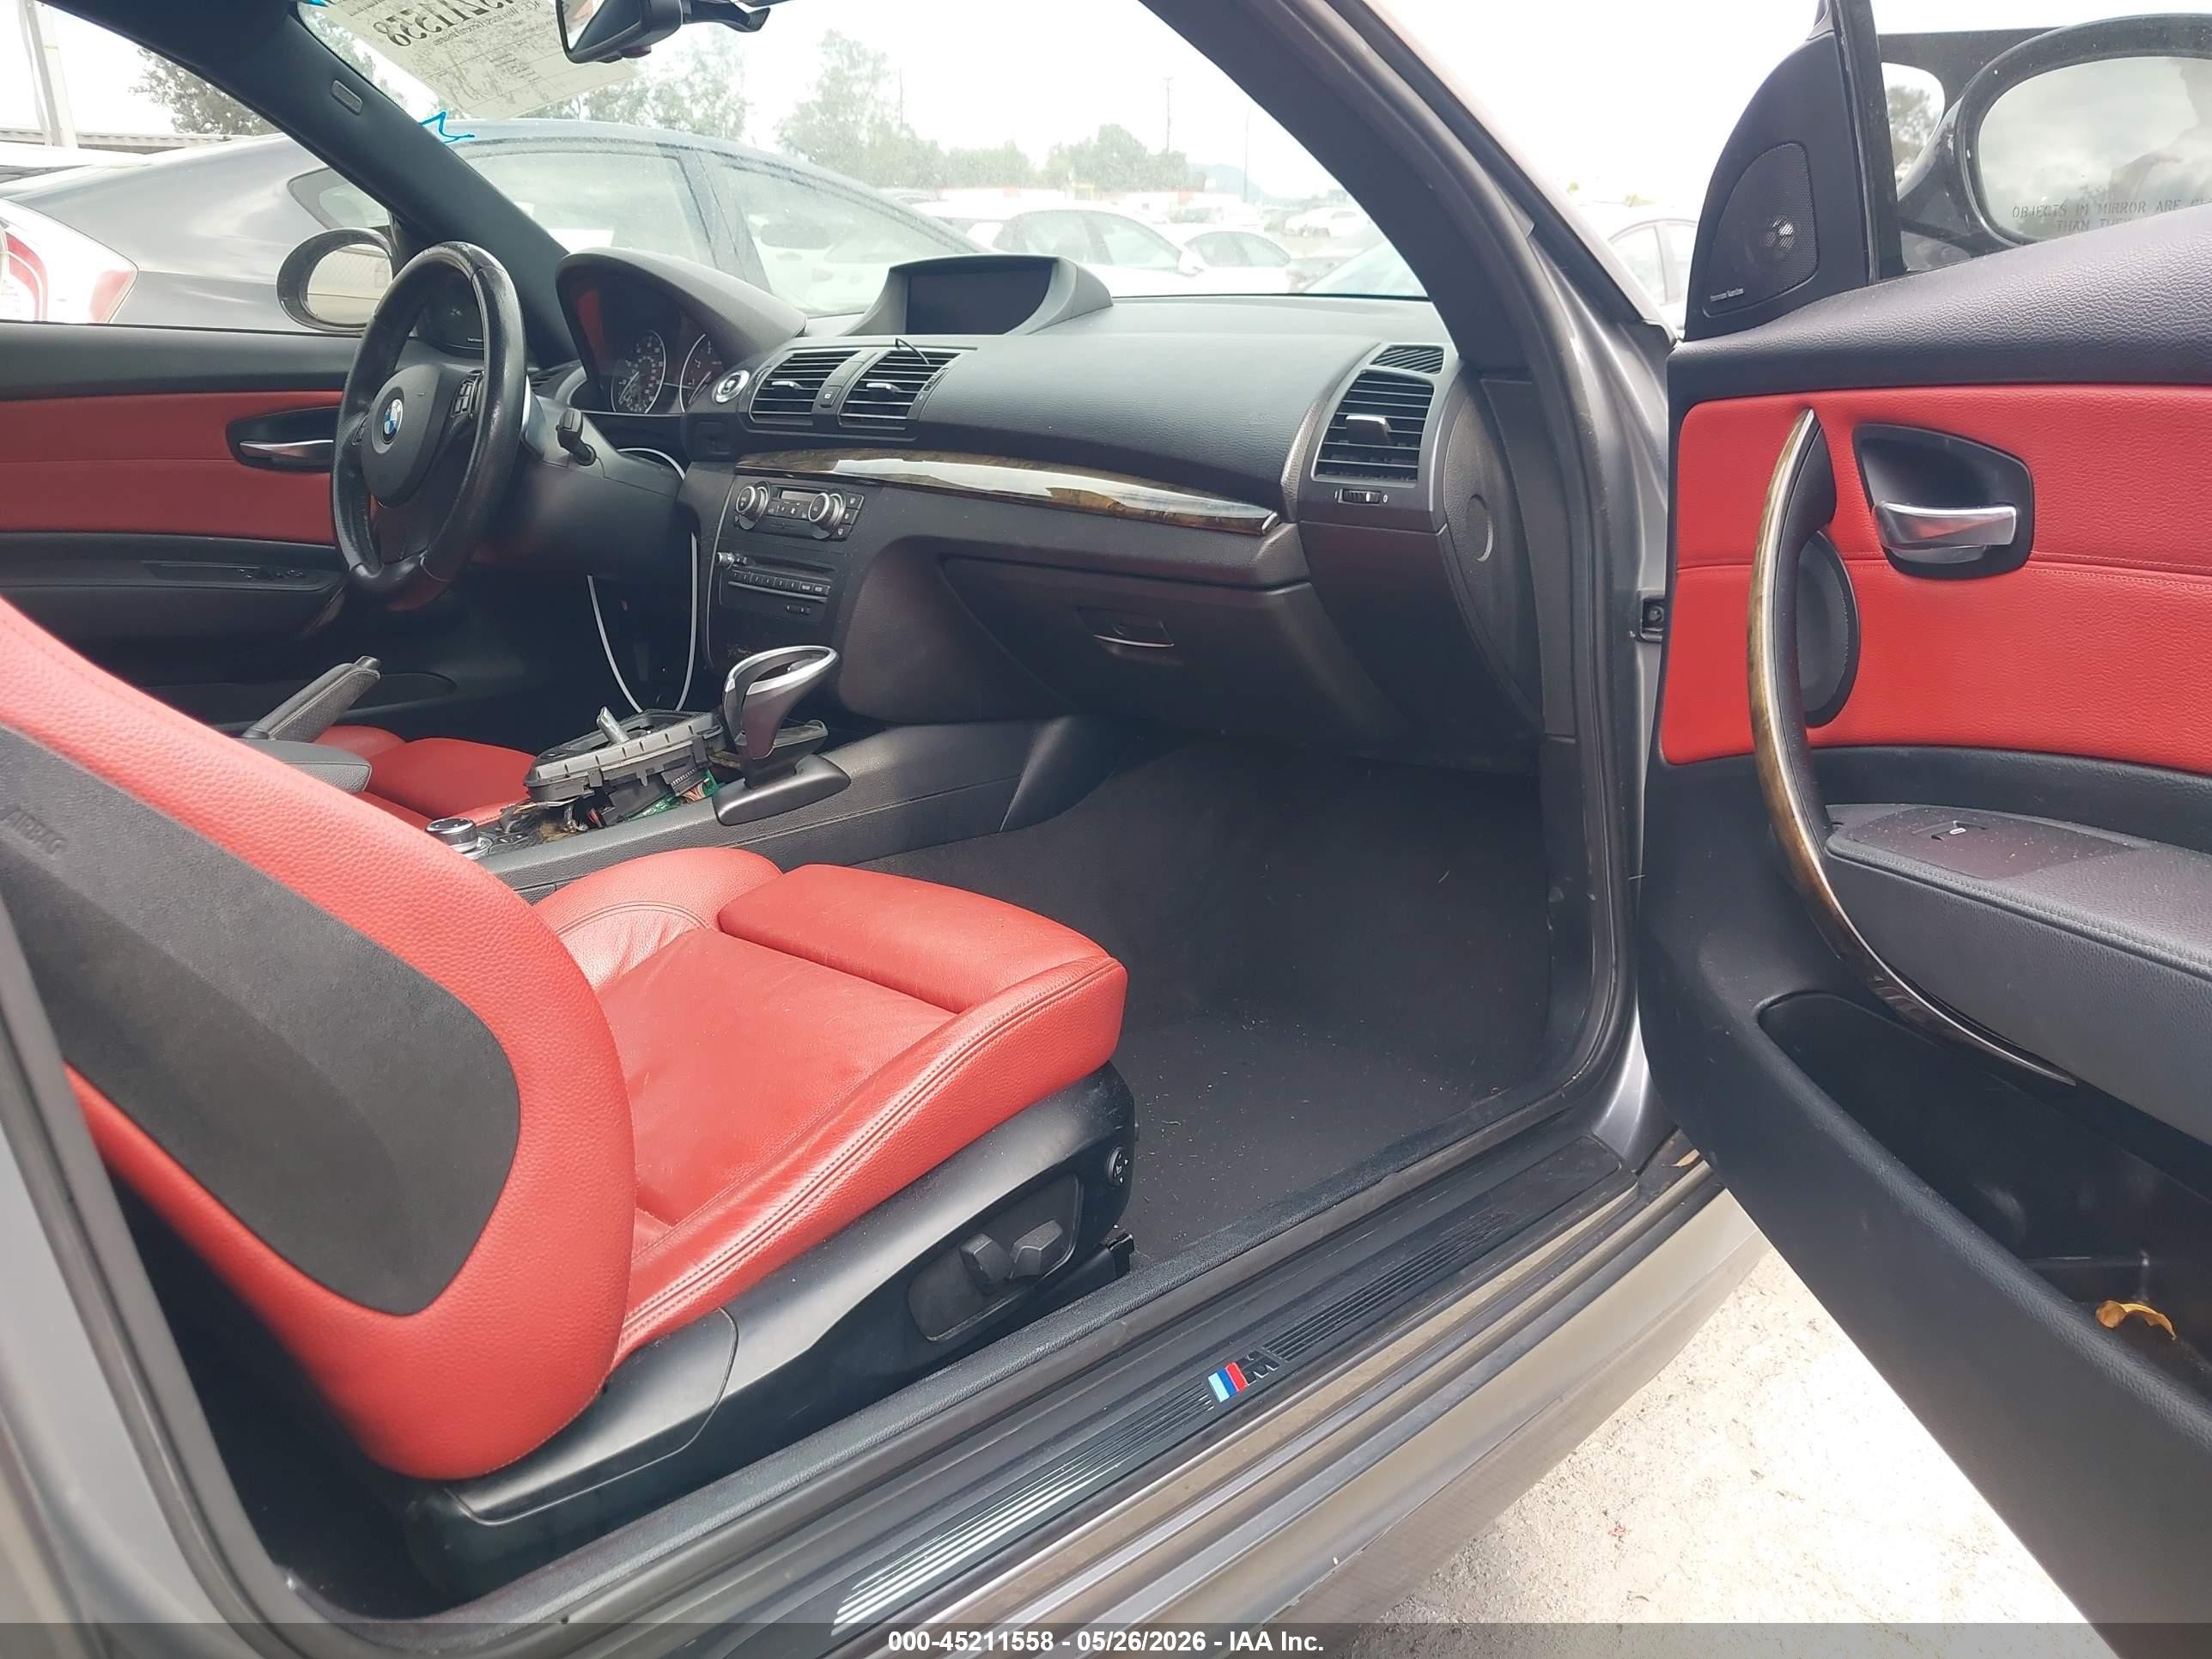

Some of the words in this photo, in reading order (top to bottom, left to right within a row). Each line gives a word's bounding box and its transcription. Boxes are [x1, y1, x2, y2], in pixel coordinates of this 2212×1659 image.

[2012, 204, 2068, 218] OBJECTS
[2075, 203, 2089, 216] IN
[2098, 201, 2147, 214] MIRROR
